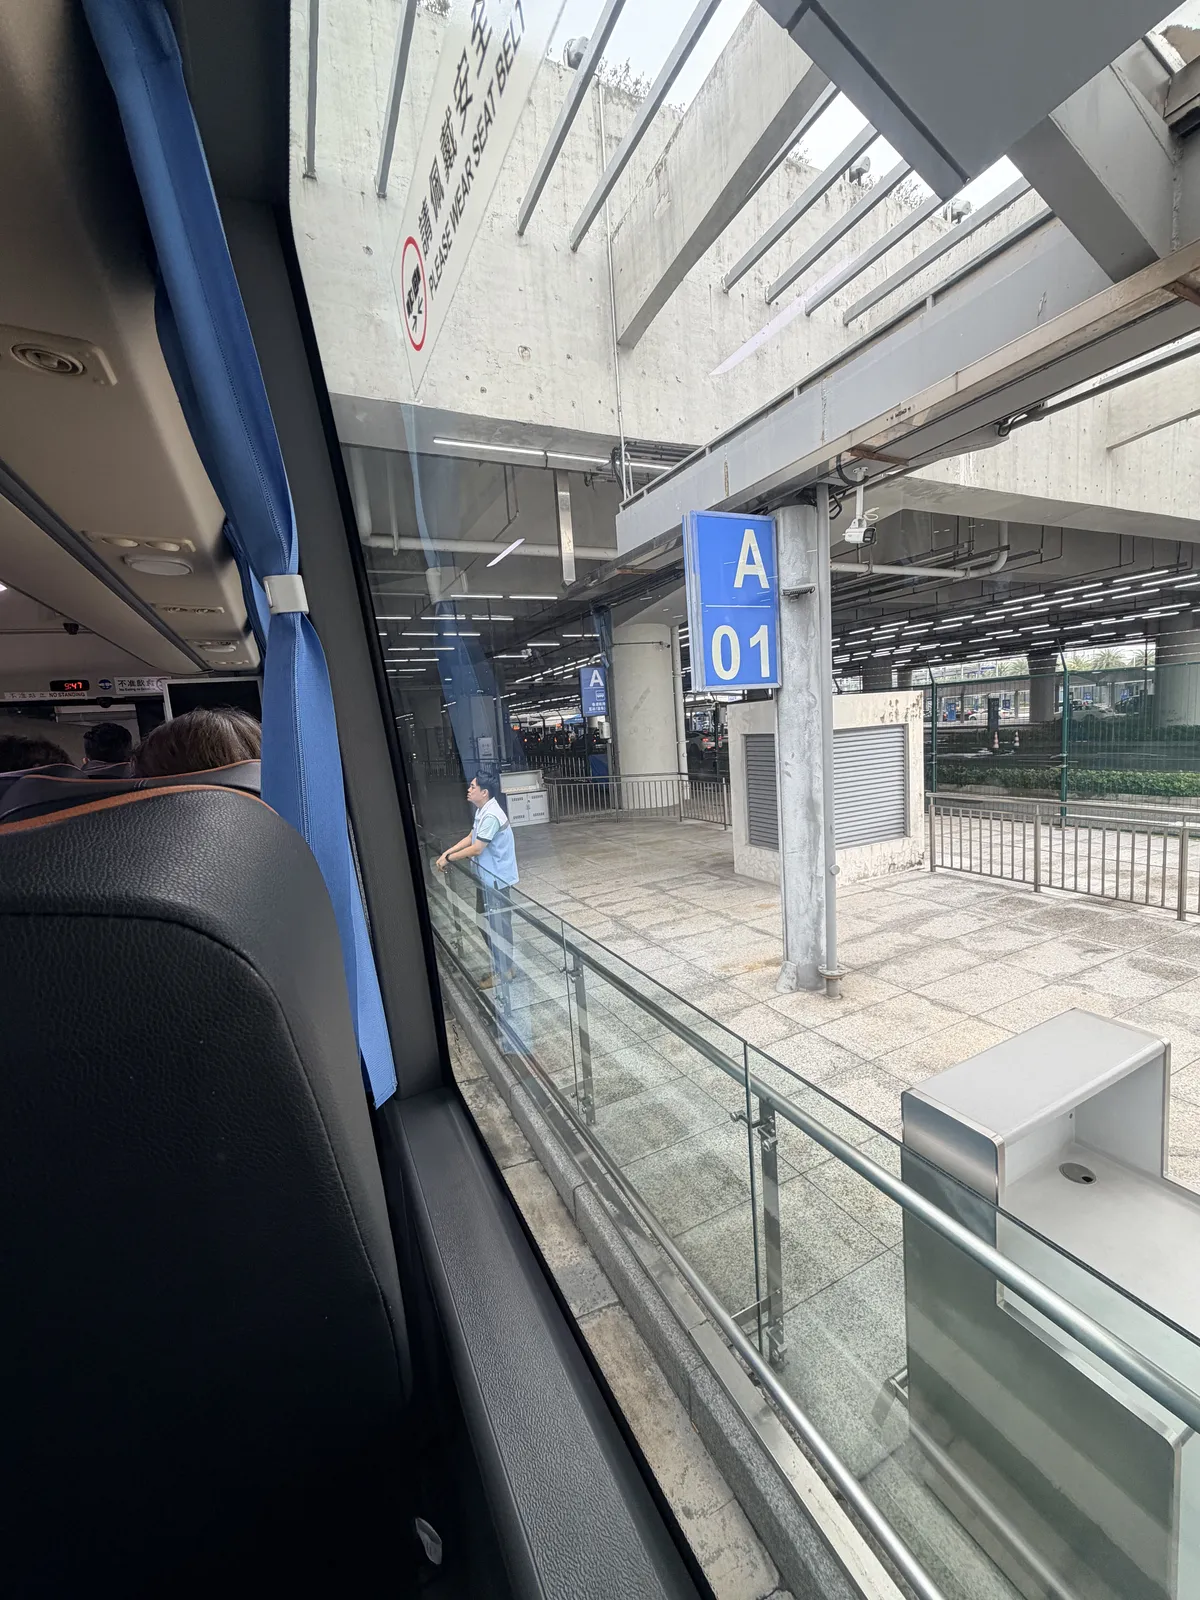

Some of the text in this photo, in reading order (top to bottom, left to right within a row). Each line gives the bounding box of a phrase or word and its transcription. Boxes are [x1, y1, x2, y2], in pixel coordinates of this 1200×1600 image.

[418, 0, 501, 261] 請佩戴安全
[428, 0, 525, 301] PLEASE WEAR SEAT BELT
[733, 528, 770, 589] A
[589, 669, 605, 687] A
[711, 624, 771, 681] 01
[64, 681, 83, 691] 9:47
